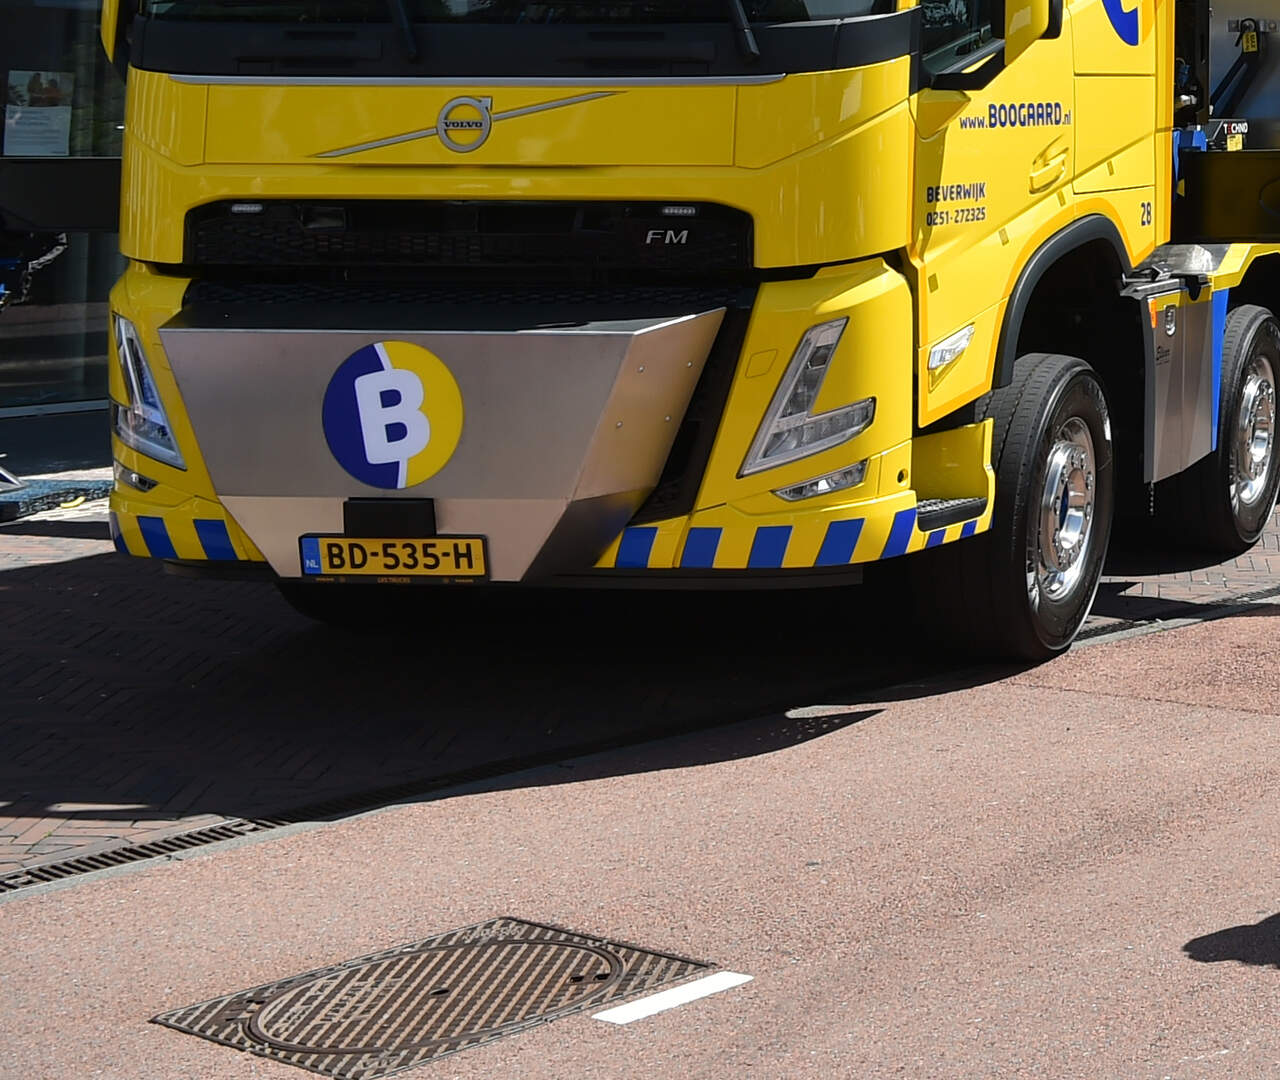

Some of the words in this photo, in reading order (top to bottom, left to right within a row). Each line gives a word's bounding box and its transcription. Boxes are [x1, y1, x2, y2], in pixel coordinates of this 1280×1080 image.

[959, 102, 1072, 129] www.BOOGAARD.nl
[926, 182, 986, 203] BEVERWIJK
[926, 207, 986, 227] 0251-272325
[646, 230, 689, 244] FM
[326, 542, 474, 570] BD-535-H
